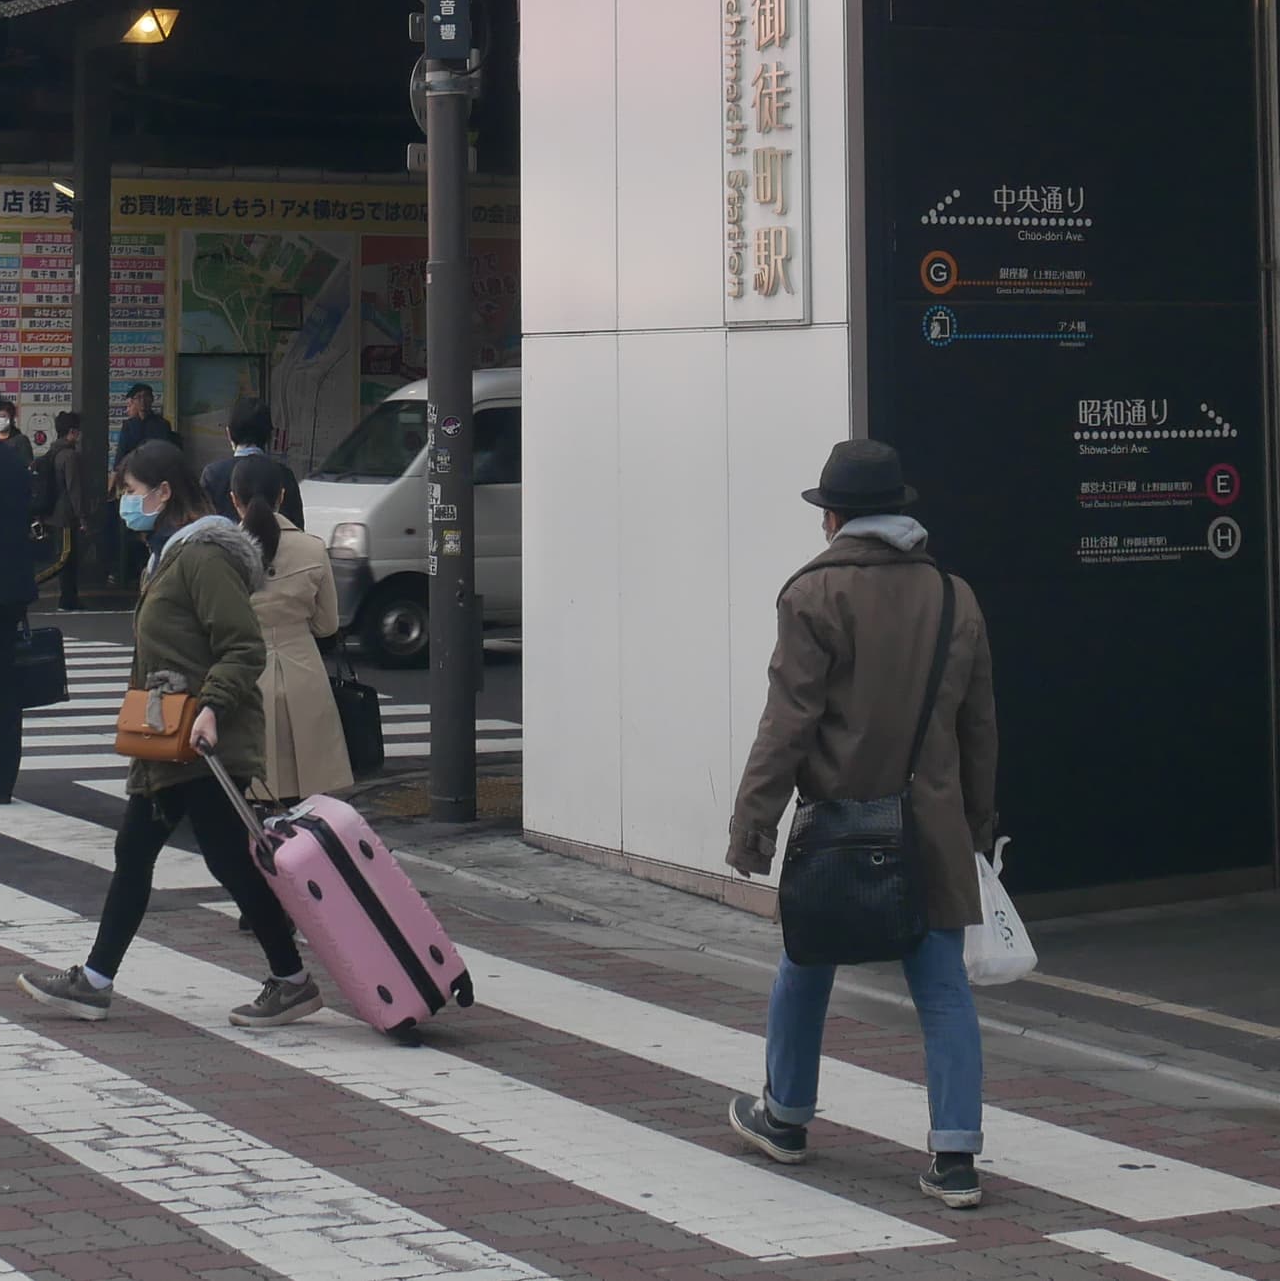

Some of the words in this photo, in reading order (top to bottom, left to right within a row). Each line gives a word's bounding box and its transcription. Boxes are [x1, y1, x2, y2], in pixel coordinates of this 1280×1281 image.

[994, 184, 1084, 214] 中央通り
[727, 170, 748, 299] Station
[930, 263, 947, 281] G
[1058, 321, 1087, 332] アメ横
[1079, 399, 1167, 427] 昭和通り
[1216, 475, 1230, 493] E
[1217, 528, 1232, 547] H
